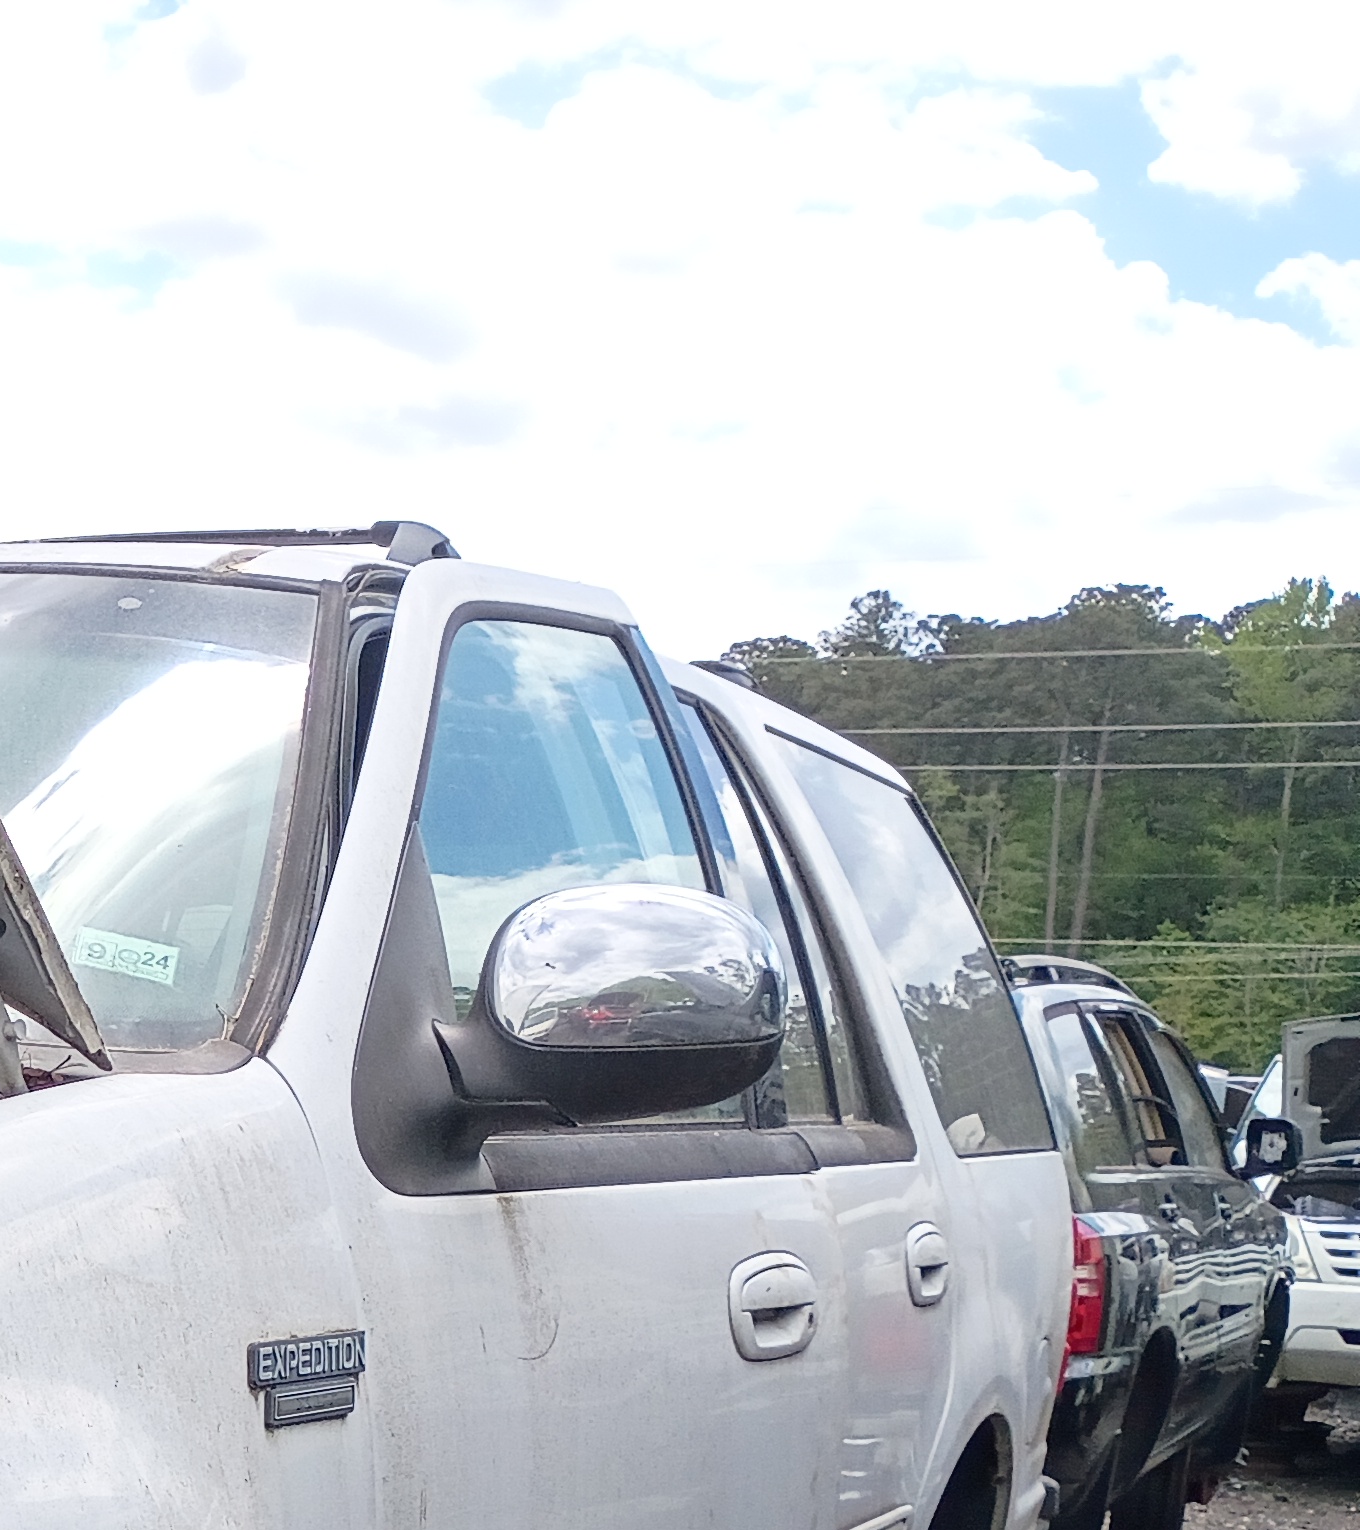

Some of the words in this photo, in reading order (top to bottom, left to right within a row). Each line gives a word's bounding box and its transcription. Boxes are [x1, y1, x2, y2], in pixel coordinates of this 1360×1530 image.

[88, 943, 106, 959] 9
[142, 951, 169, 969] 24
[259, 1336, 365, 1380] EXPEDITION
